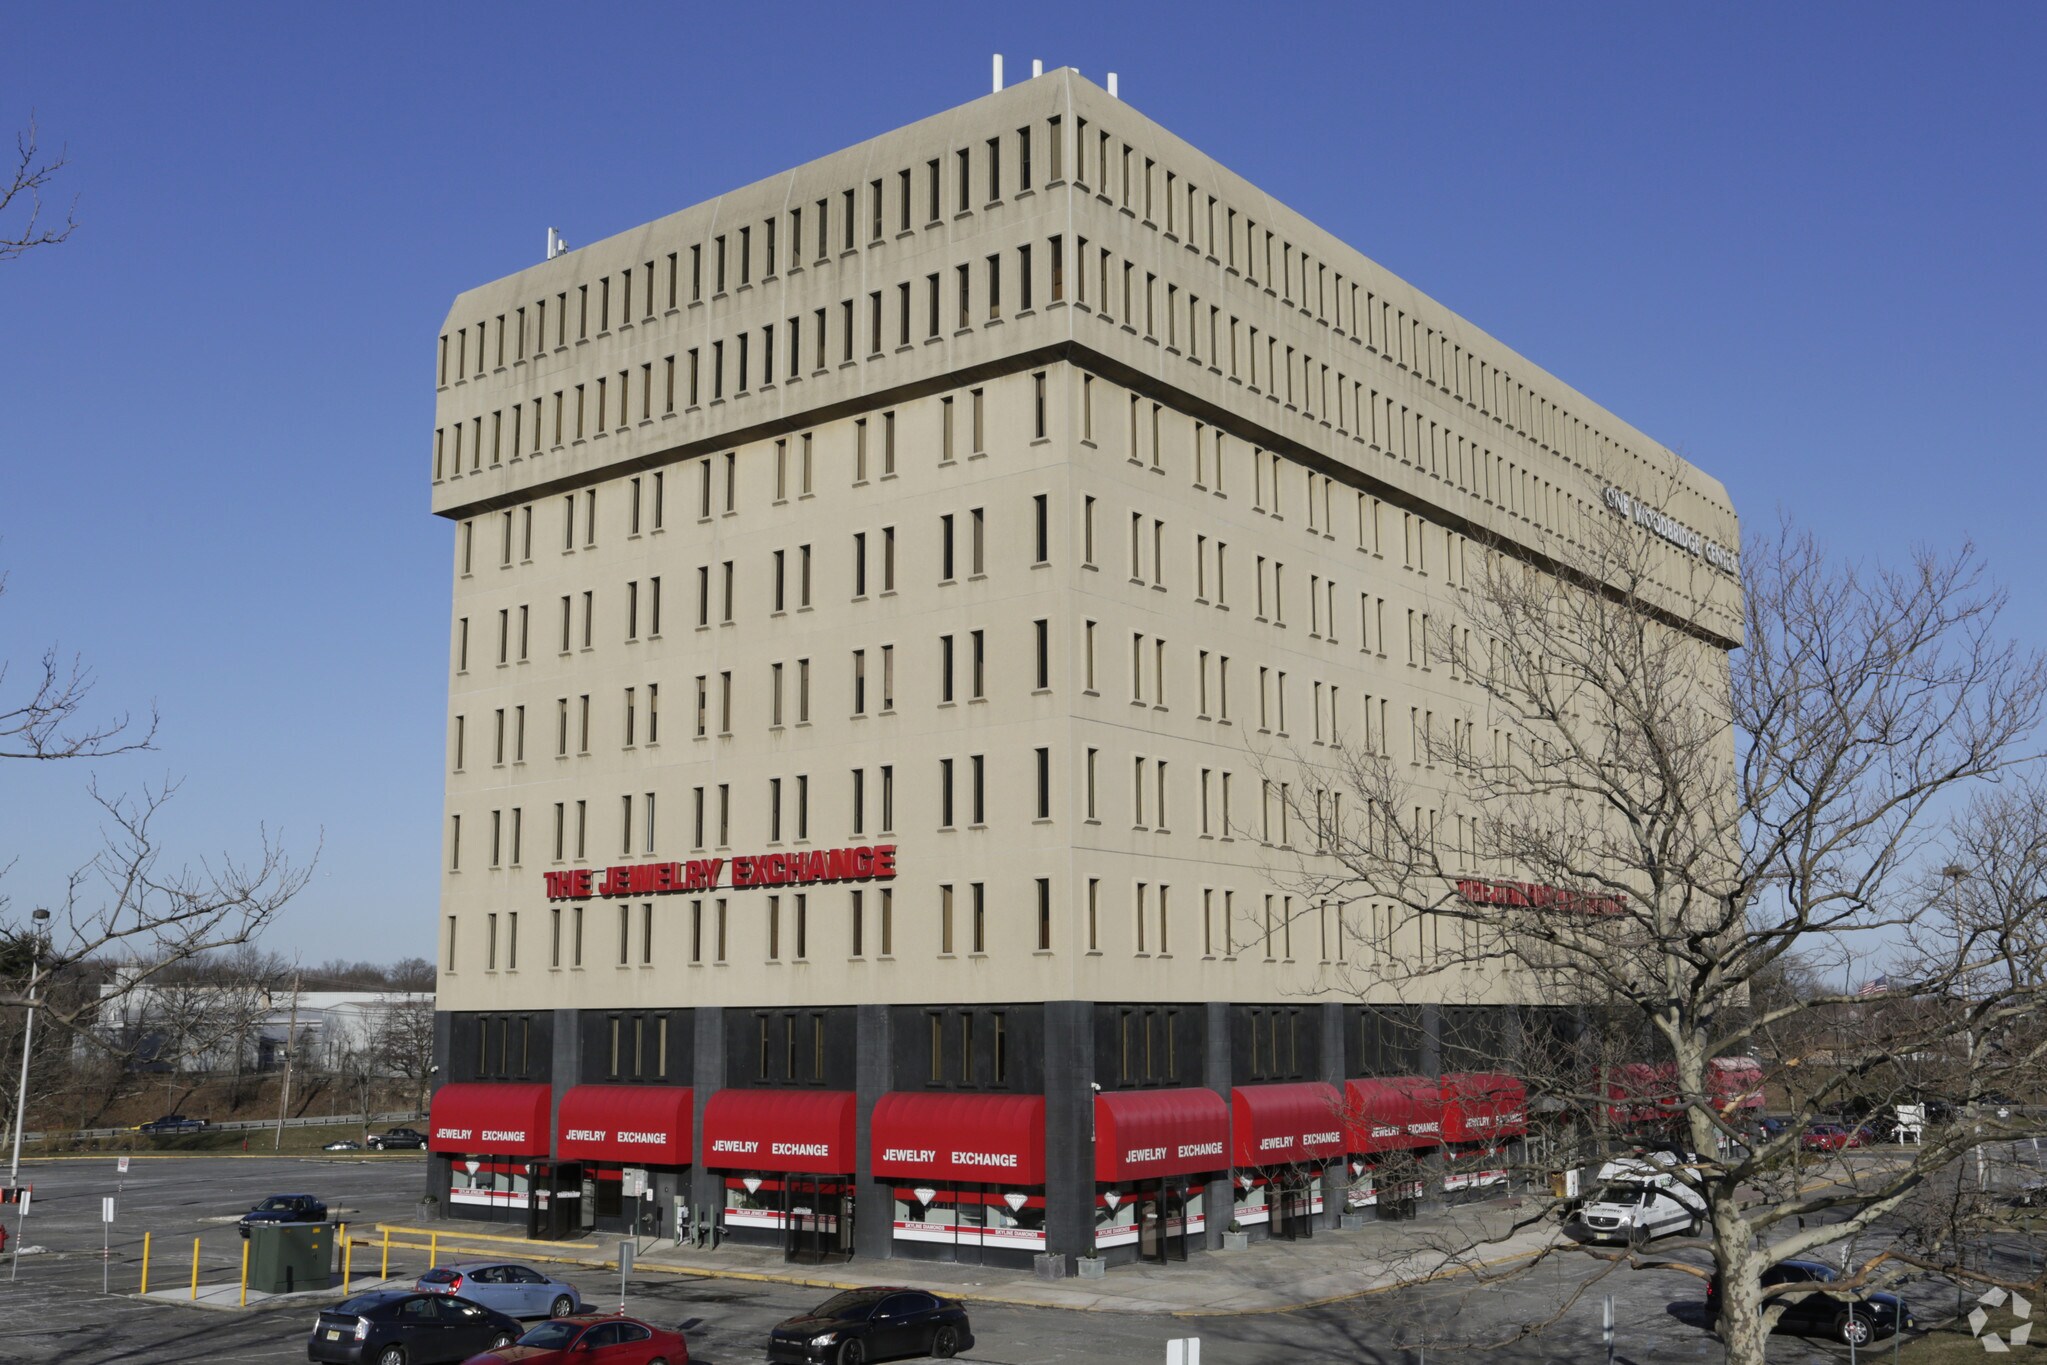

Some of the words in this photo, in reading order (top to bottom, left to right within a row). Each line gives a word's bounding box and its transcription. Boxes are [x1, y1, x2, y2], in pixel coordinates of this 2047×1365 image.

[1602, 487, 1629, 516] ONE
[1632, 501, 1701, 555] WOODBRIDGE
[1704, 543, 1737, 571] CENTER
[544, 869, 592, 898] THE
[599, 858, 723, 895] JEWELRY
[732, 845, 898, 886] EXCHANGE
[436, 1128, 472, 1140] JEWELRY
[482, 1130, 525, 1142] EXCHANGE
[566, 1129, 606, 1142] JEWELRY
[617, 1131, 667, 1144] EXCHANGE
[1371, 1126, 1399, 1138] JEWELRY
[1408, 1122, 1439, 1134] EXCHANGE
[712, 1139, 758, 1153] JEWELRY
[771, 1142, 829, 1157] EXCHANGE
[1259, 1135, 1294, 1150] JEWELRY
[1303, 1131, 1341, 1146] EXCHANGE
[882, 1148, 936, 1163] JEWELRY
[951, 1151, 1018, 1167] EXCHANGE
[1125, 1147, 1167, 1163] JEWELRY
[1178, 1141, 1223, 1158] EXCHANGE
[1014, 1230, 1038, 1238] DIAMONDS
